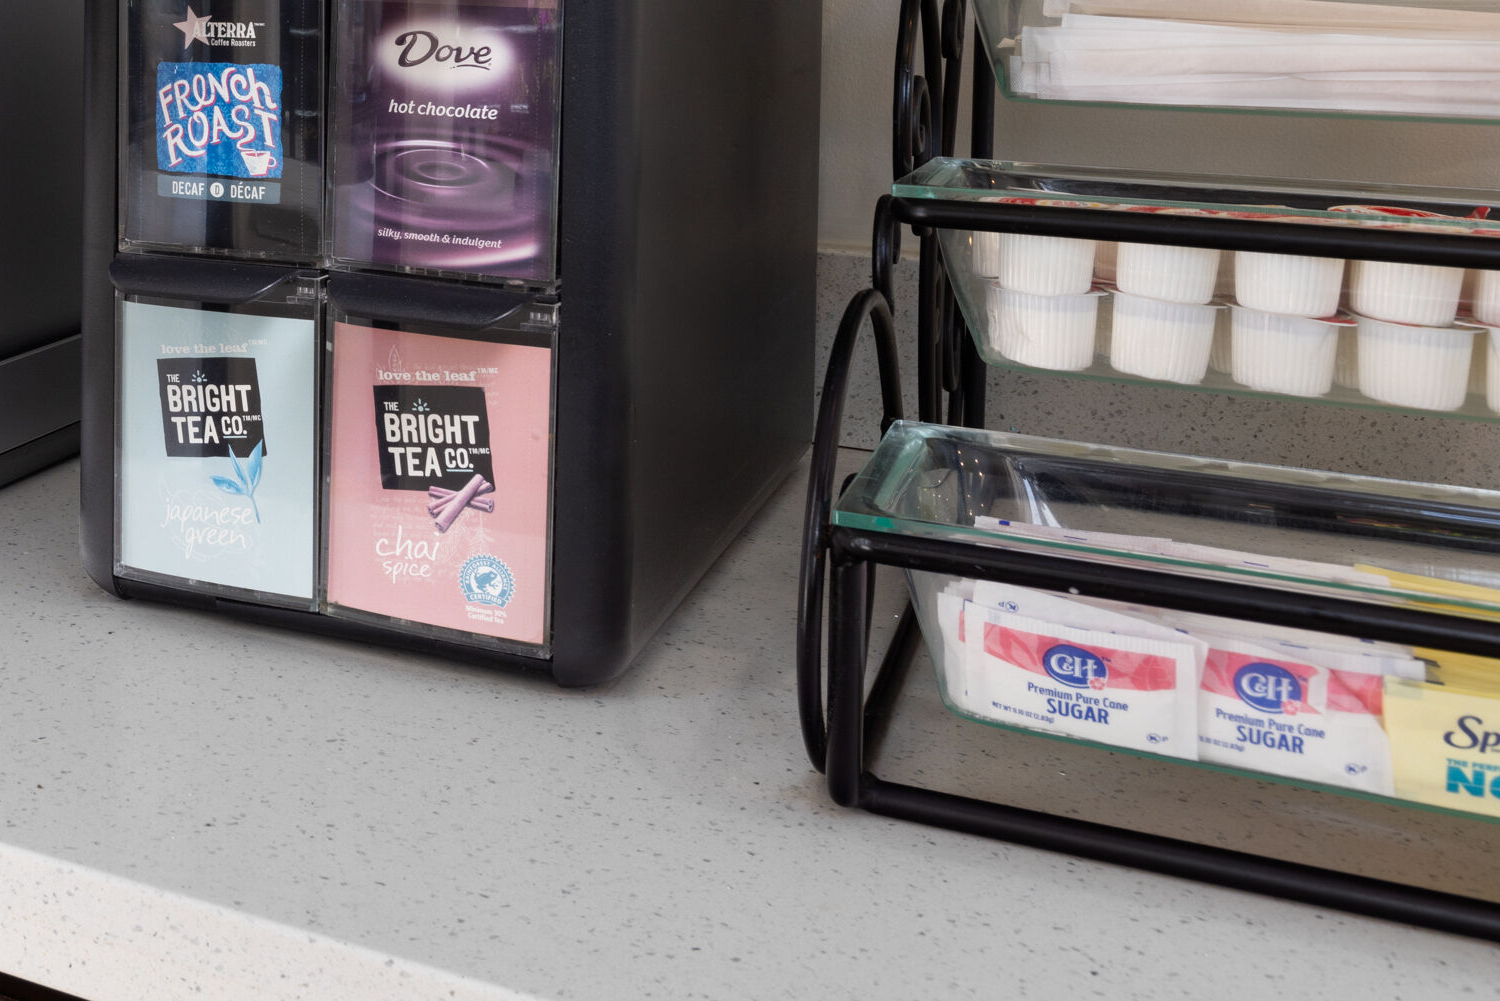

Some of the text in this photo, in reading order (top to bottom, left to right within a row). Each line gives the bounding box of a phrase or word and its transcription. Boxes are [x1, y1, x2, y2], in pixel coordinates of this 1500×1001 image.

[193, 21, 256, 39] ALTERRA
[210, 38, 256, 47] Coffee Roasters
[394, 30, 492, 69] Dove
[388, 99, 498, 120] hot chocolate
[163, 105, 278, 168] ROAST
[171, 181, 205, 196] DECAF
[230, 181, 266, 200] DÉCAF
[377, 227, 502, 249] silky, smooth & indulgent
[160, 342, 248, 354] love the leaf
[166, 373, 180, 383] THE
[378, 370, 411, 381] love
[415, 370, 440, 381] the
[444, 370, 477, 381] leaf
[166, 384, 252, 413] BRIGHT
[383, 401, 399, 412] THE
[171, 415, 220, 444] TEA
[221, 415, 248, 436] CO.
[383, 413, 480, 444] BRIGHT
[387, 446, 442, 477] TEA
[444, 448, 474, 469] CO.
[160, 497, 253, 533] japanese
[185, 526, 246, 560] green
[375, 524, 440, 561] chai
[382, 556, 431, 584] spice
[1050, 653, 1097, 679] C&H
[1027, 681, 1129, 712] Premium Pure Cane
[1240, 672, 1293, 701] C&H
[1046, 698, 1110, 725] SUGAR
[1215, 707, 1325, 739] Premium Pure Cane
[1236, 725, 1305, 754] SUGAR
